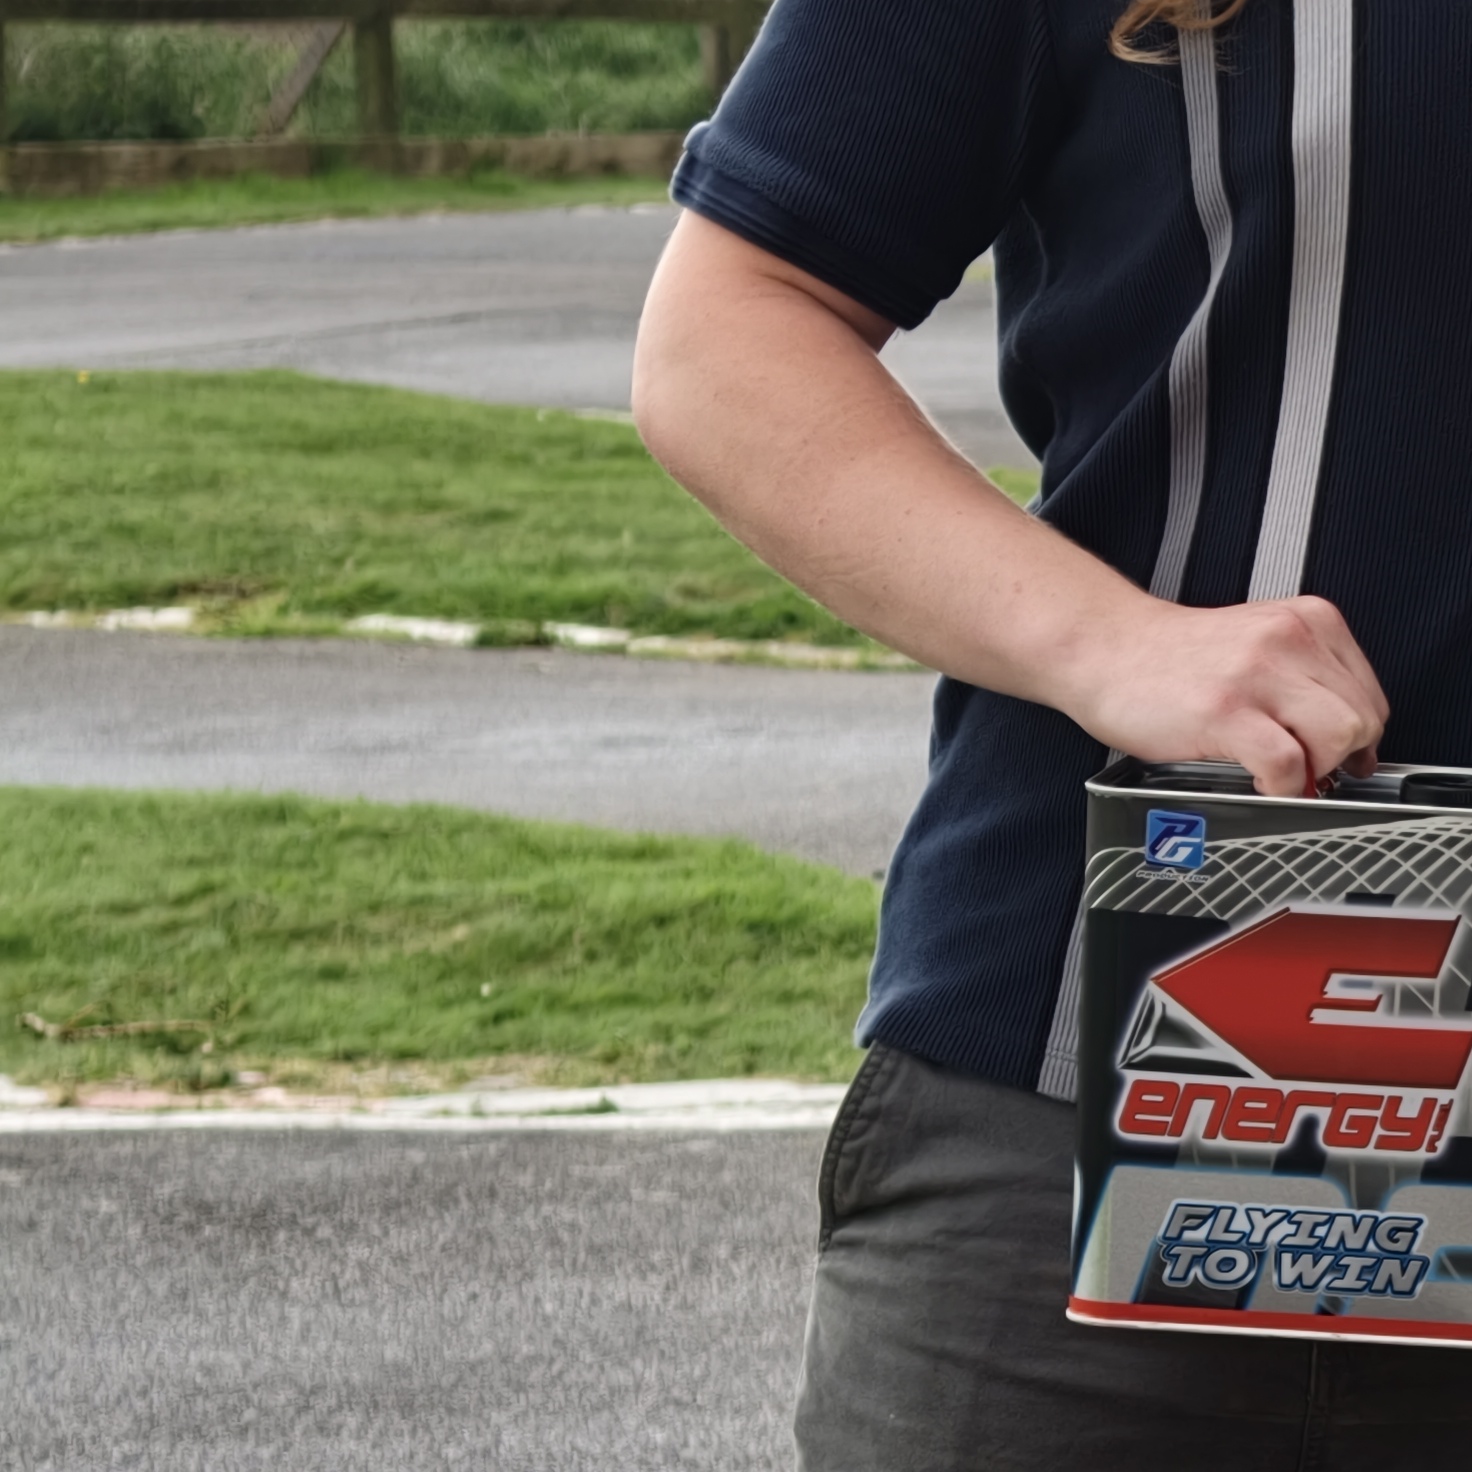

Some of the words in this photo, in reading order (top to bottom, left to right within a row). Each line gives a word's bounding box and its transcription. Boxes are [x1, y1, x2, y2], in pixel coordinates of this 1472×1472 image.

[1163, 1202, 1426, 1255] FLYING
[1168, 1243, 1258, 1290] TO
[1277, 1249, 1432, 1298] WIN
